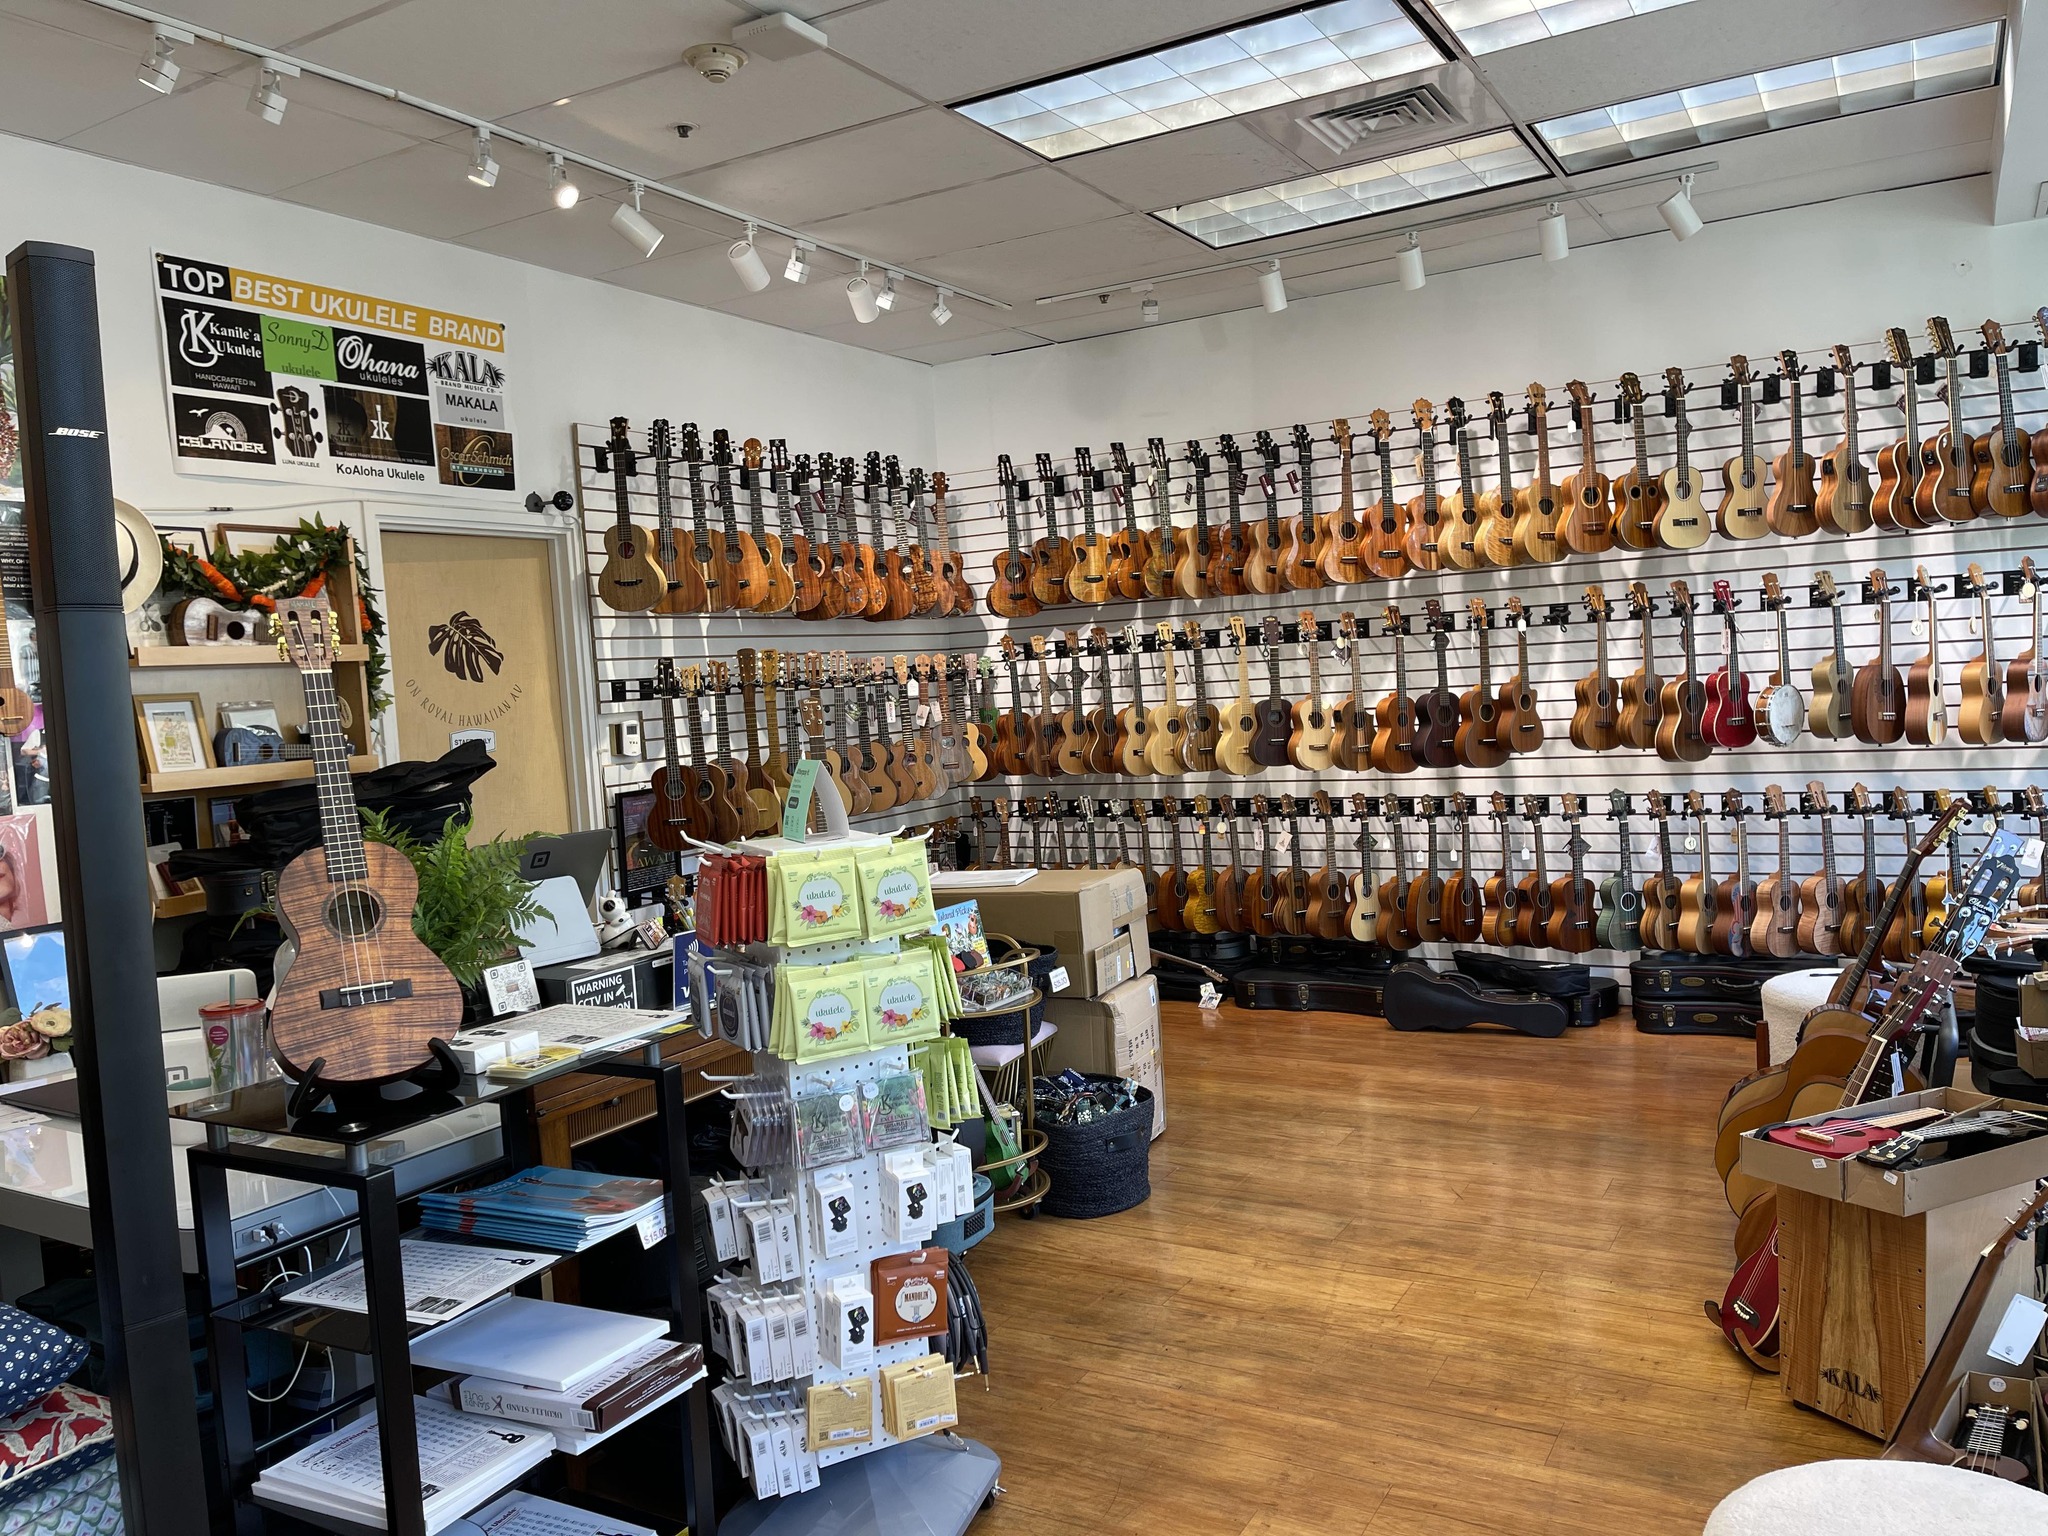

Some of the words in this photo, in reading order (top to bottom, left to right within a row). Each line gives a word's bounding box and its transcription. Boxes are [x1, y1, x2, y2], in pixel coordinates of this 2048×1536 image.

[163, 263, 225, 295] TOP
[234, 276, 304, 309] BEST
[310, 290, 416, 332] UKULELE
[428, 318, 501, 348] BRAND
[336, 335, 420, 379] Ohana
[281, 362, 321, 378] ukulele
[434, 350, 500, 389] KALA
[195, 372, 247, 386] HANDCRAFTED
[359, 371, 404, 387] ukuleles
[440, 380, 462, 389] BRAND
[464, 384, 484, 393] MUSIC
[445, 393, 499, 413] MAKALA
[460, 415, 487, 425] ukulele
[50, 427, 103, 439] BOSE
[179, 435, 268, 454] ISLANDER
[440, 446, 472, 462] Oscar
[471, 450, 513, 466] Schmidt
[336, 463, 384, 478] KoAloha
[387, 468, 425, 481] Ukulele
[406, 679, 422, 697] ON
[420, 698, 453, 725] ROYAL
[458, 700, 512, 727] HAWAIIAN
[511, 684, 523, 702] AV
[806, 889, 836, 901] ukulele
[884, 883, 912, 896] ukulele
[937, 909, 955, 922] Island
[576, 975, 622, 995] WARNING
[578, 995, 601, 1006] CCTV
[603, 991, 614, 1003] IN
[887, 993, 917, 1006] ukulele
[815, 1005, 846, 1018] ukulele
[904, 1291, 929, 1303] MANDOLIN
[575, 1364, 633, 1399] UKULELE
[633, 1342, 673, 1365] STAND
[1826, 1368, 1877, 1403] KALA
[506, 1403, 529, 1413] STAND
[530, 1407, 563, 1419] UKULELE
